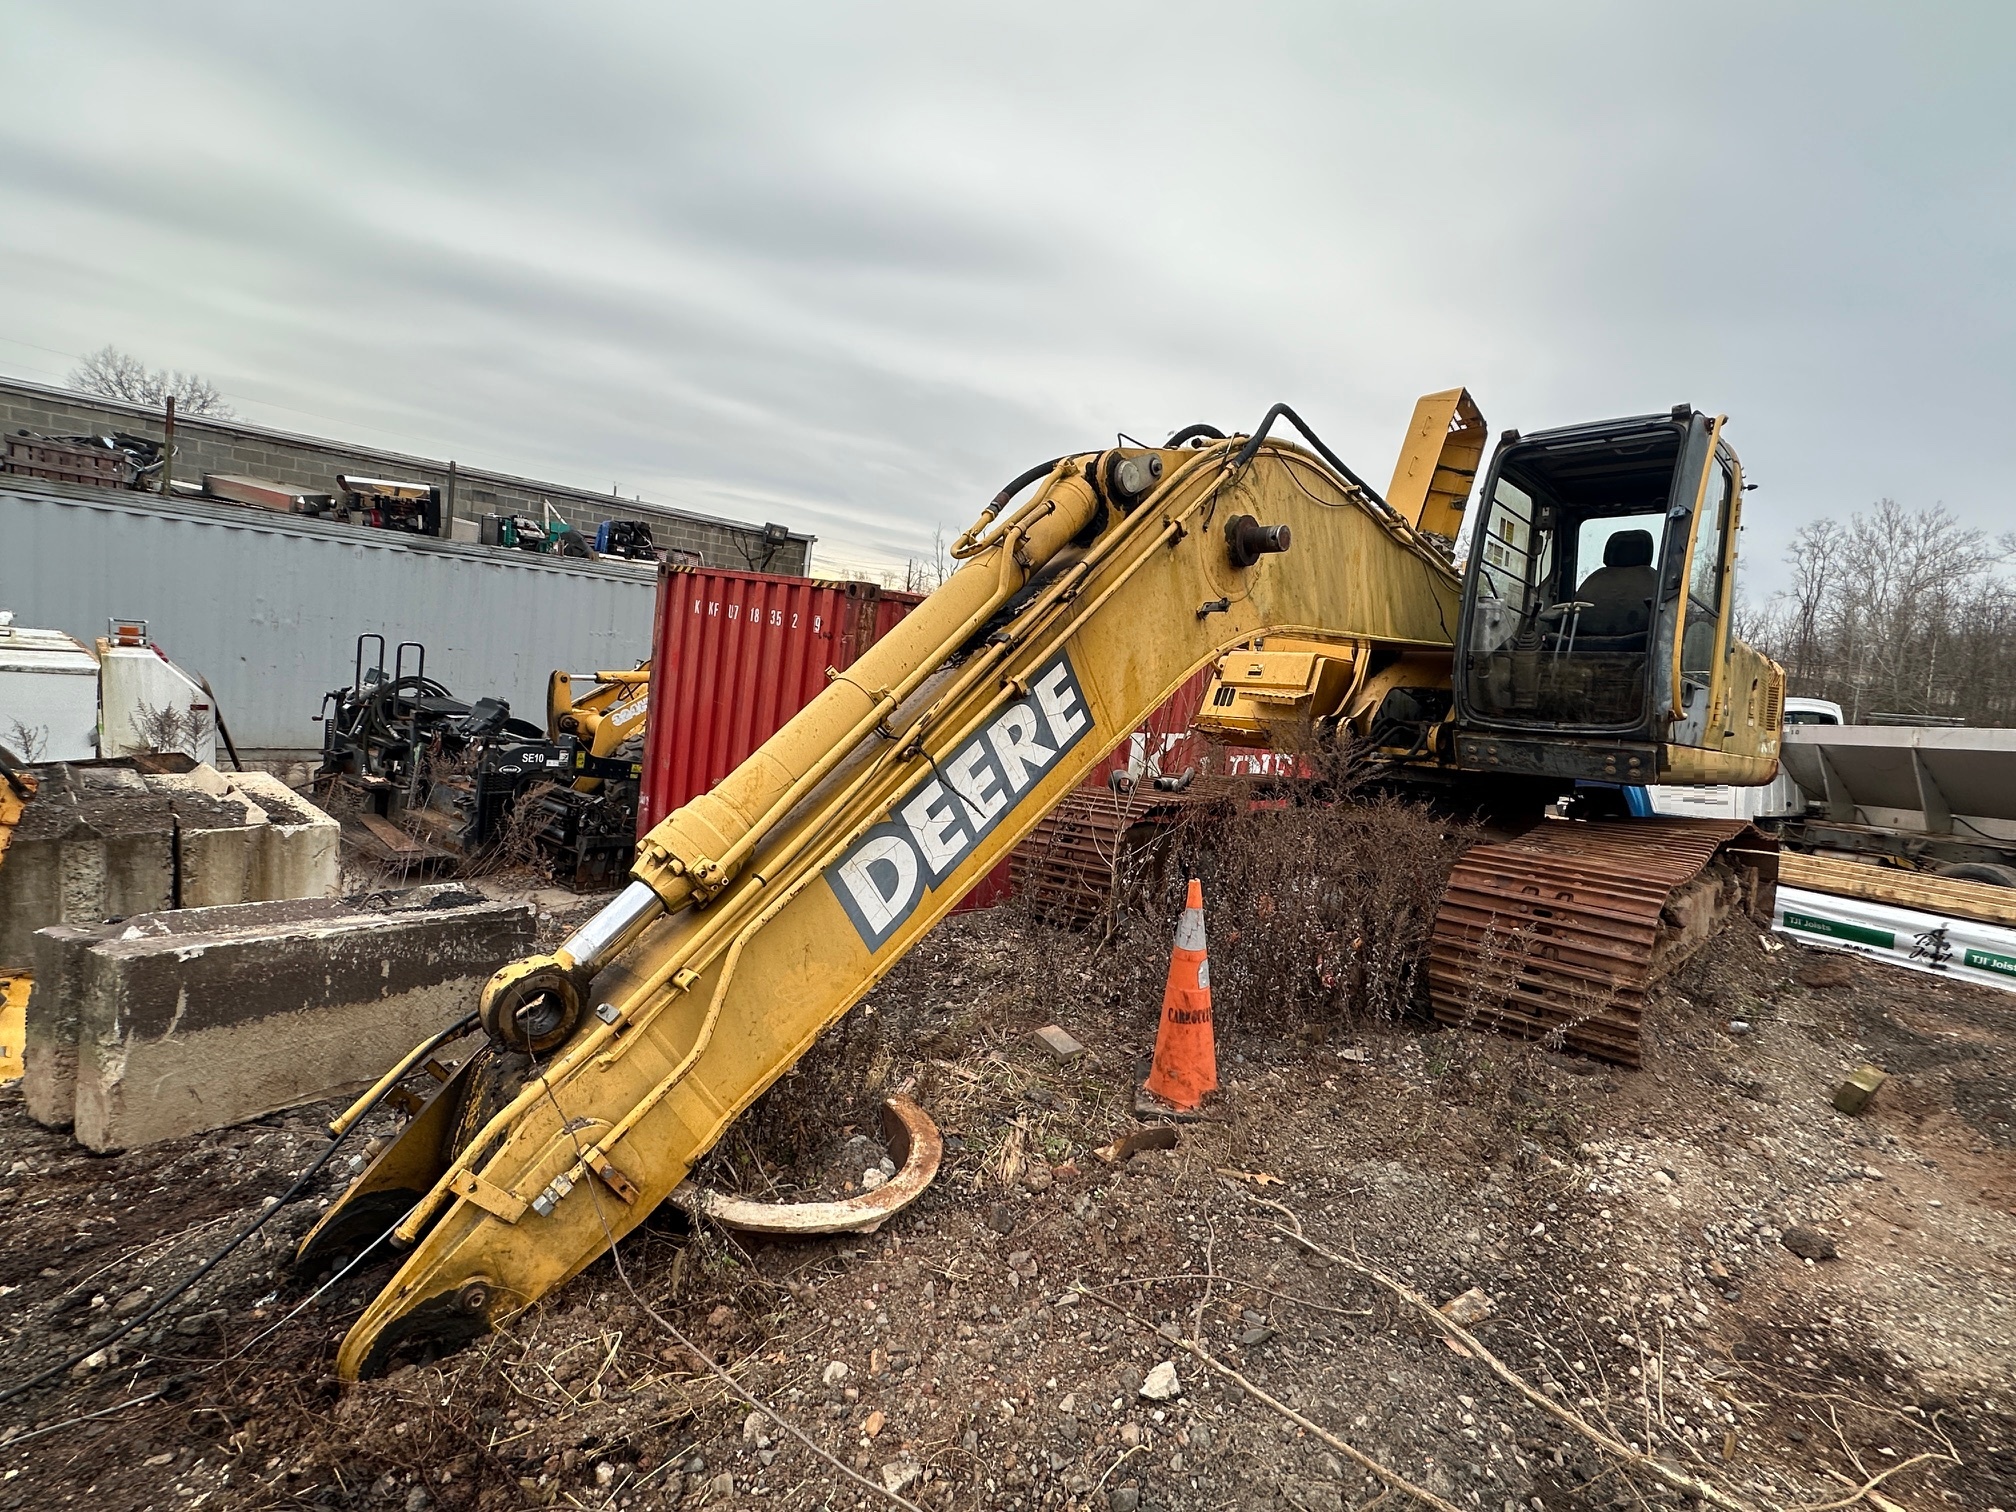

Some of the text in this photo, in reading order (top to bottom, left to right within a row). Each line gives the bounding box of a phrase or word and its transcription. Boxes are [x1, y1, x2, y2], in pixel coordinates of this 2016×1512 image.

[521, 753, 544, 763] SE10
[837, 661, 1087, 936] DEERE
[1803, 920, 1832, 932] Joists
